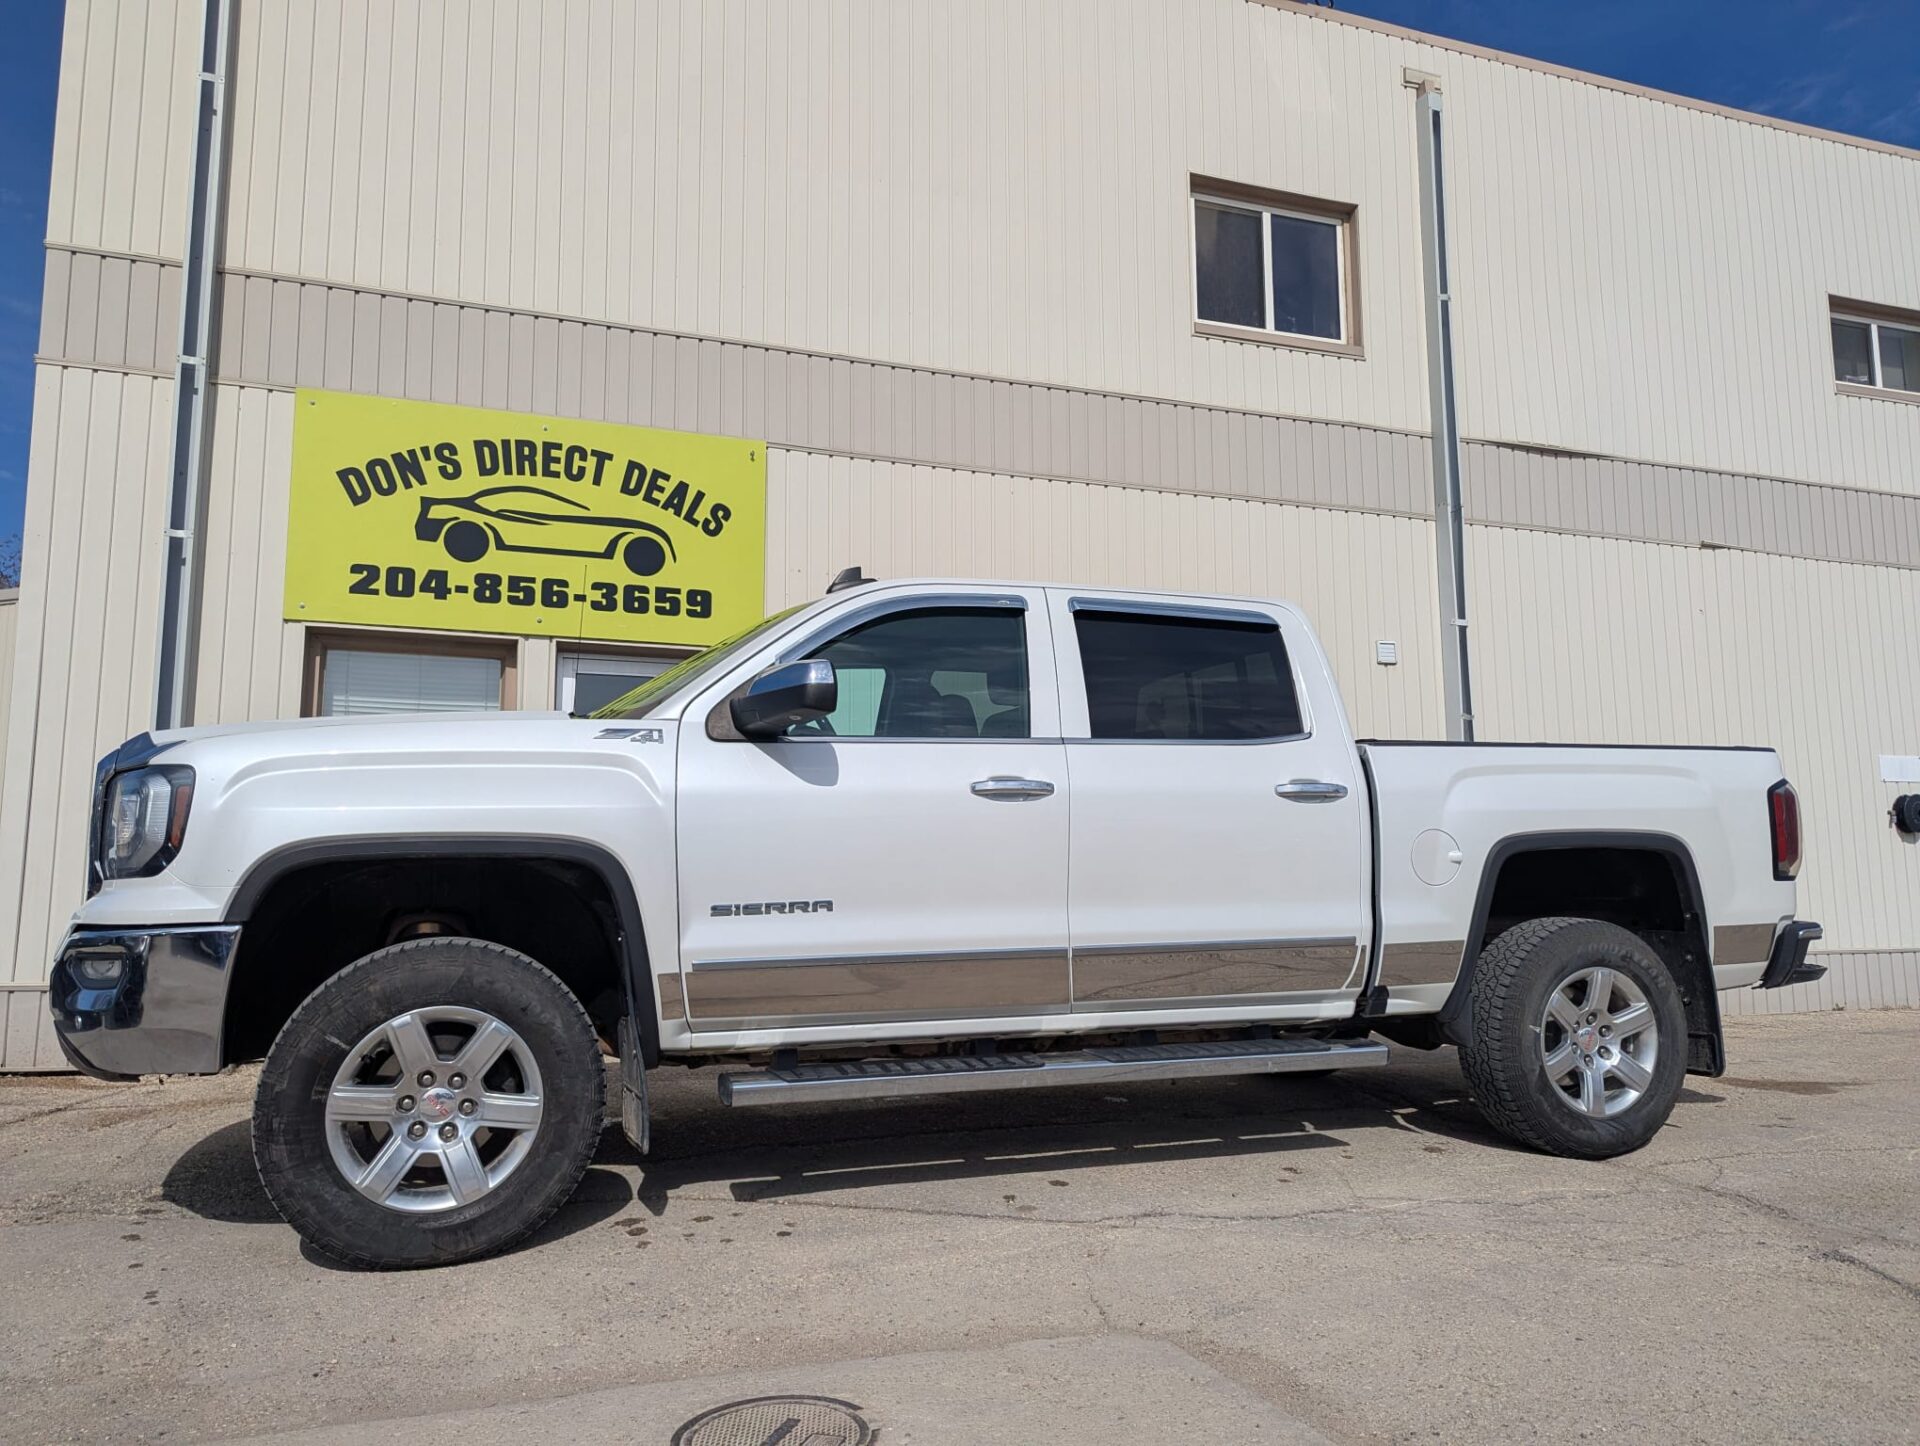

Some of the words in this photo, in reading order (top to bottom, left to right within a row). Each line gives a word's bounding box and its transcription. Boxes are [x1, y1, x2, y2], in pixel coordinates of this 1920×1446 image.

[335, 442, 463, 507] DON'S
[473, 438, 614, 487] DIRECT
[619, 459, 732, 538] DEALS
[348, 563, 713, 619] 204-856-3659
[710, 899, 834, 917] SIERRA
